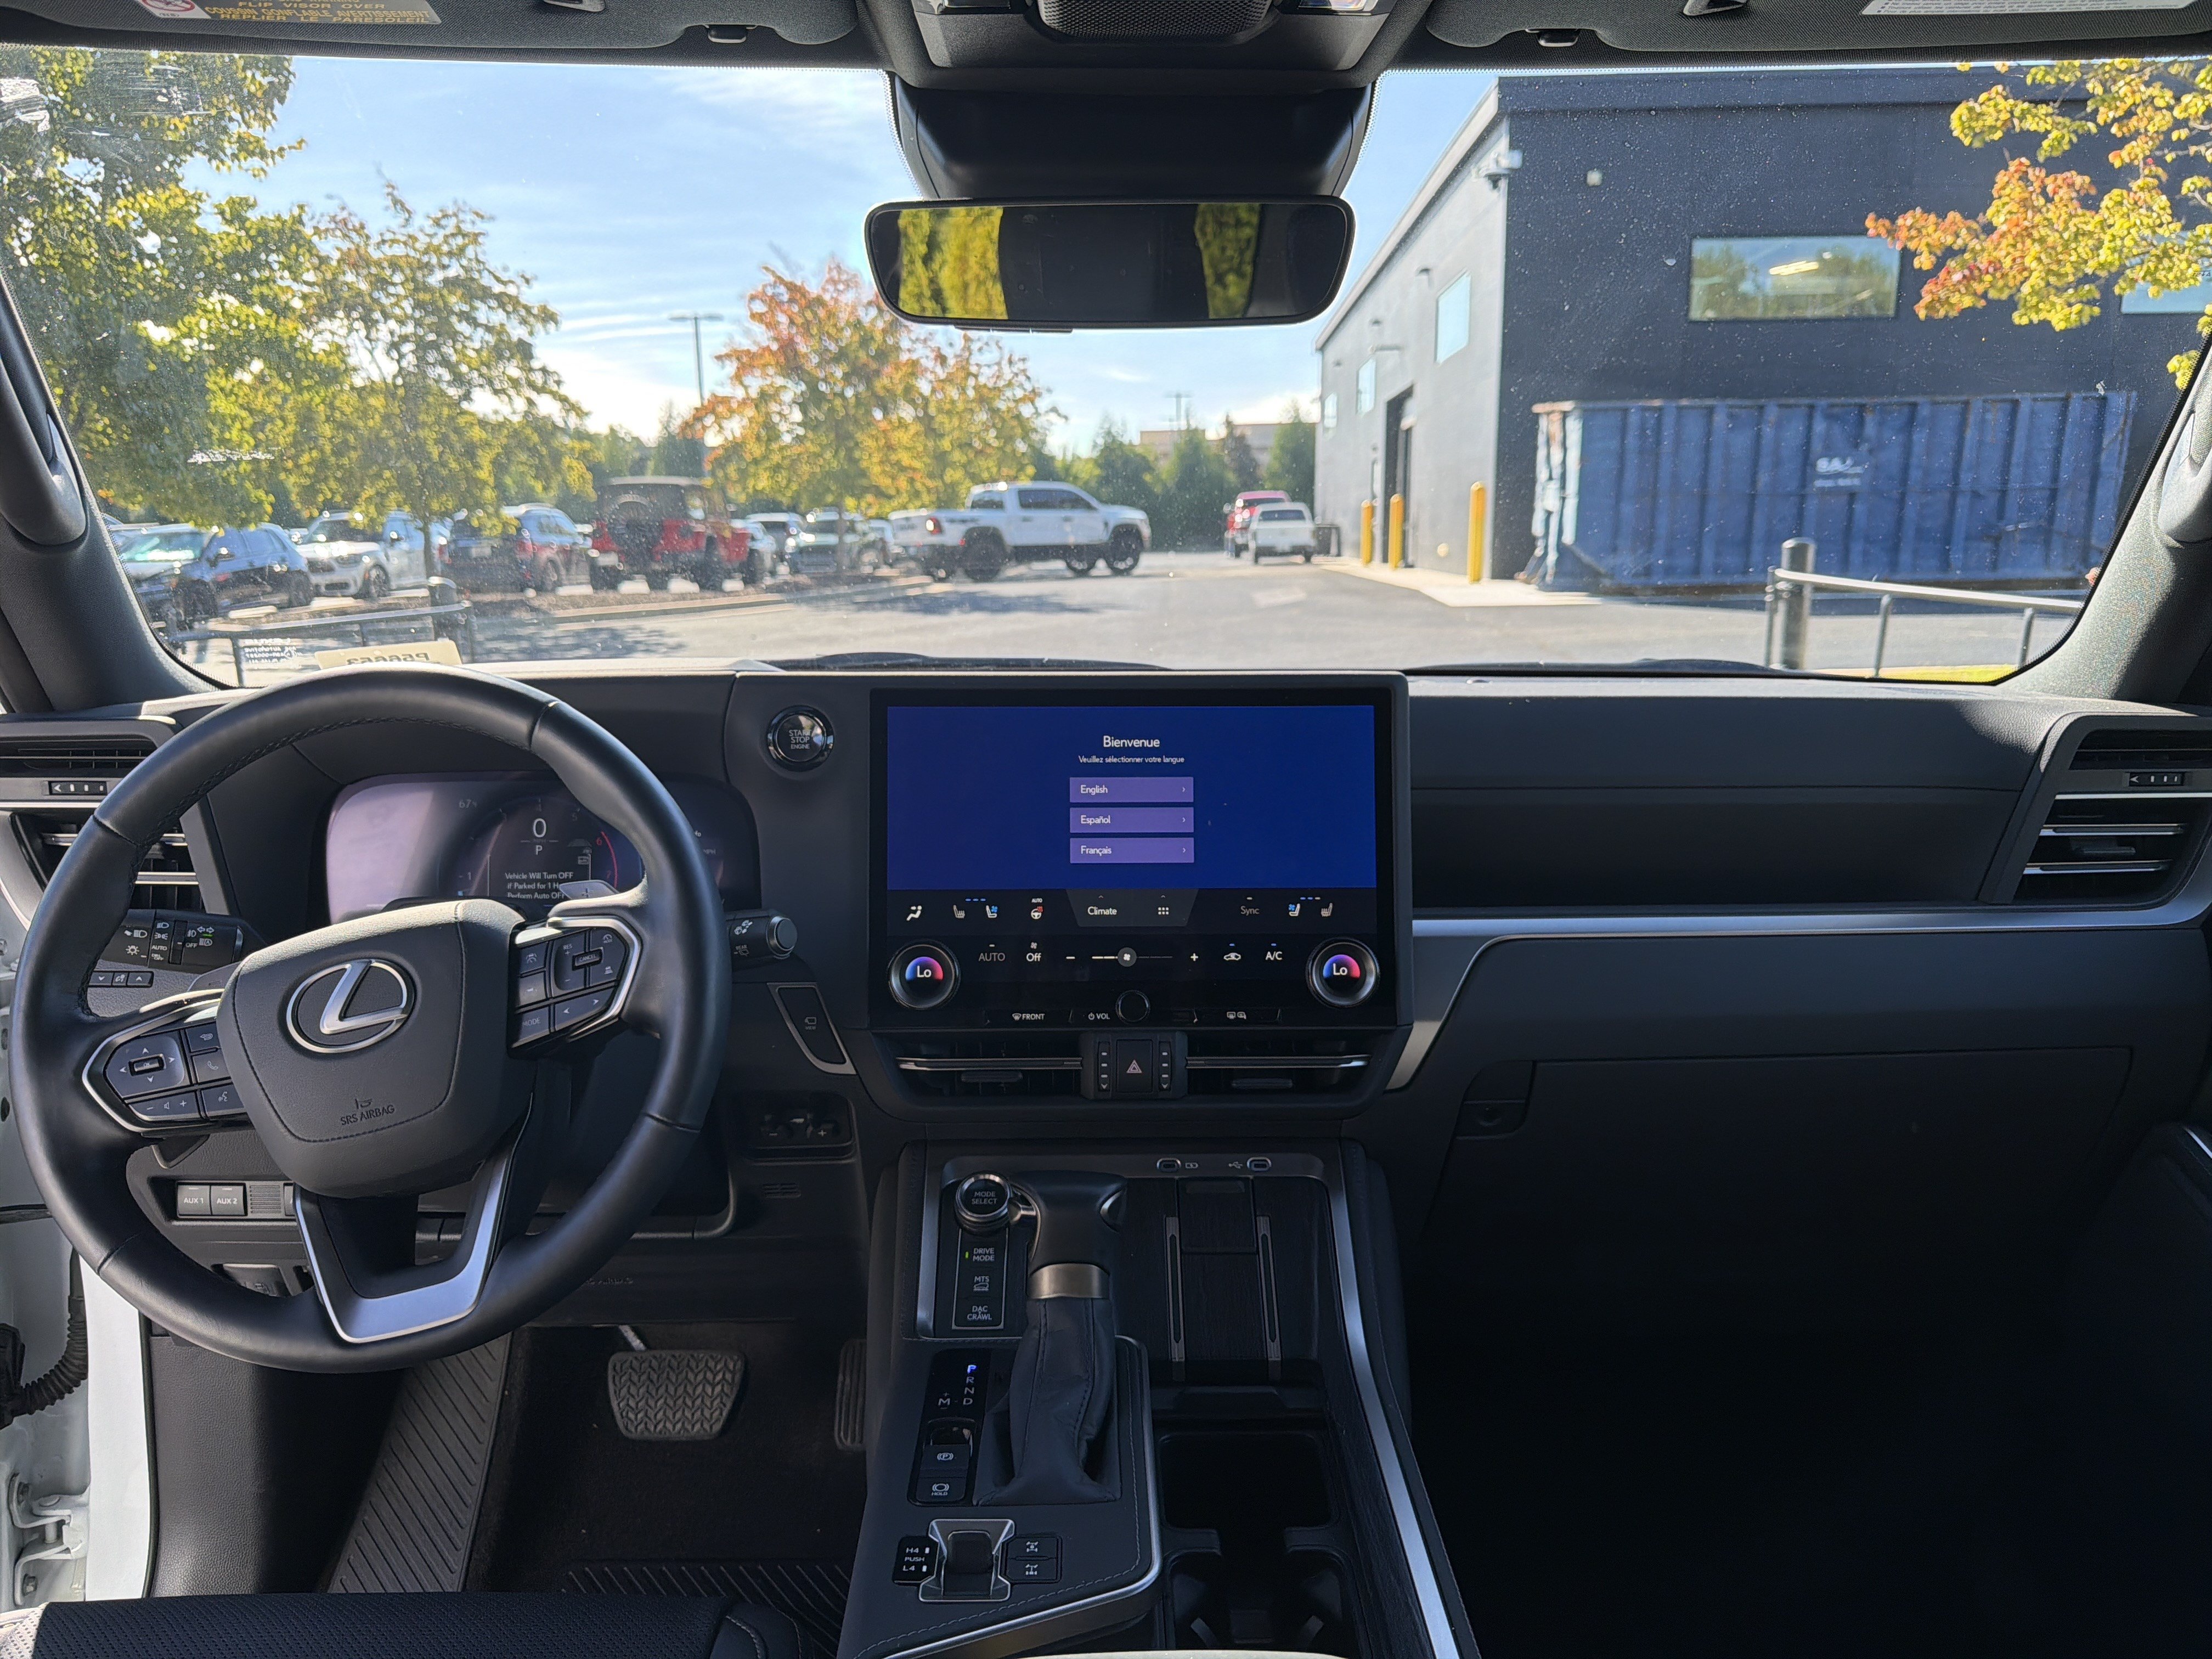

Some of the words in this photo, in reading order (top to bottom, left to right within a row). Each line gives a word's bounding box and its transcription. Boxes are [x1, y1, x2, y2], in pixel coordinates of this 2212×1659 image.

[205, 7, 258, 15] COUSSIN
[262, 9, 333, 17] GONFLABLE
[1103, 735, 1160, 747] Bienvenue
[1079, 755, 1103, 763] Veuillez
[1105, 755, 1144, 763] sélectionner
[1163, 755, 1184, 765] langue
[1080, 785, 1108, 795] English
[1080, 815, 1111, 825] Español
[536, 845, 543, 855] P
[1081, 845, 1112, 856] Français
[1087, 906, 1118, 915] Climate
[1240, 905, 1260, 916] Sync
[579, 953, 597, 962] CANCEL
[978, 953, 1006, 961] AUTO
[1026, 953, 1042, 962] Off
[1265, 951, 1283, 960] A/C
[917, 965, 932, 978] Lo
[1333, 963, 1348, 975] Lo
[522, 1017, 541, 1026] MODE
[340, 1113, 358, 1126] SRS
[360, 1104, 396, 1121] AIRBAG
[967, 1364, 977, 1373] P
